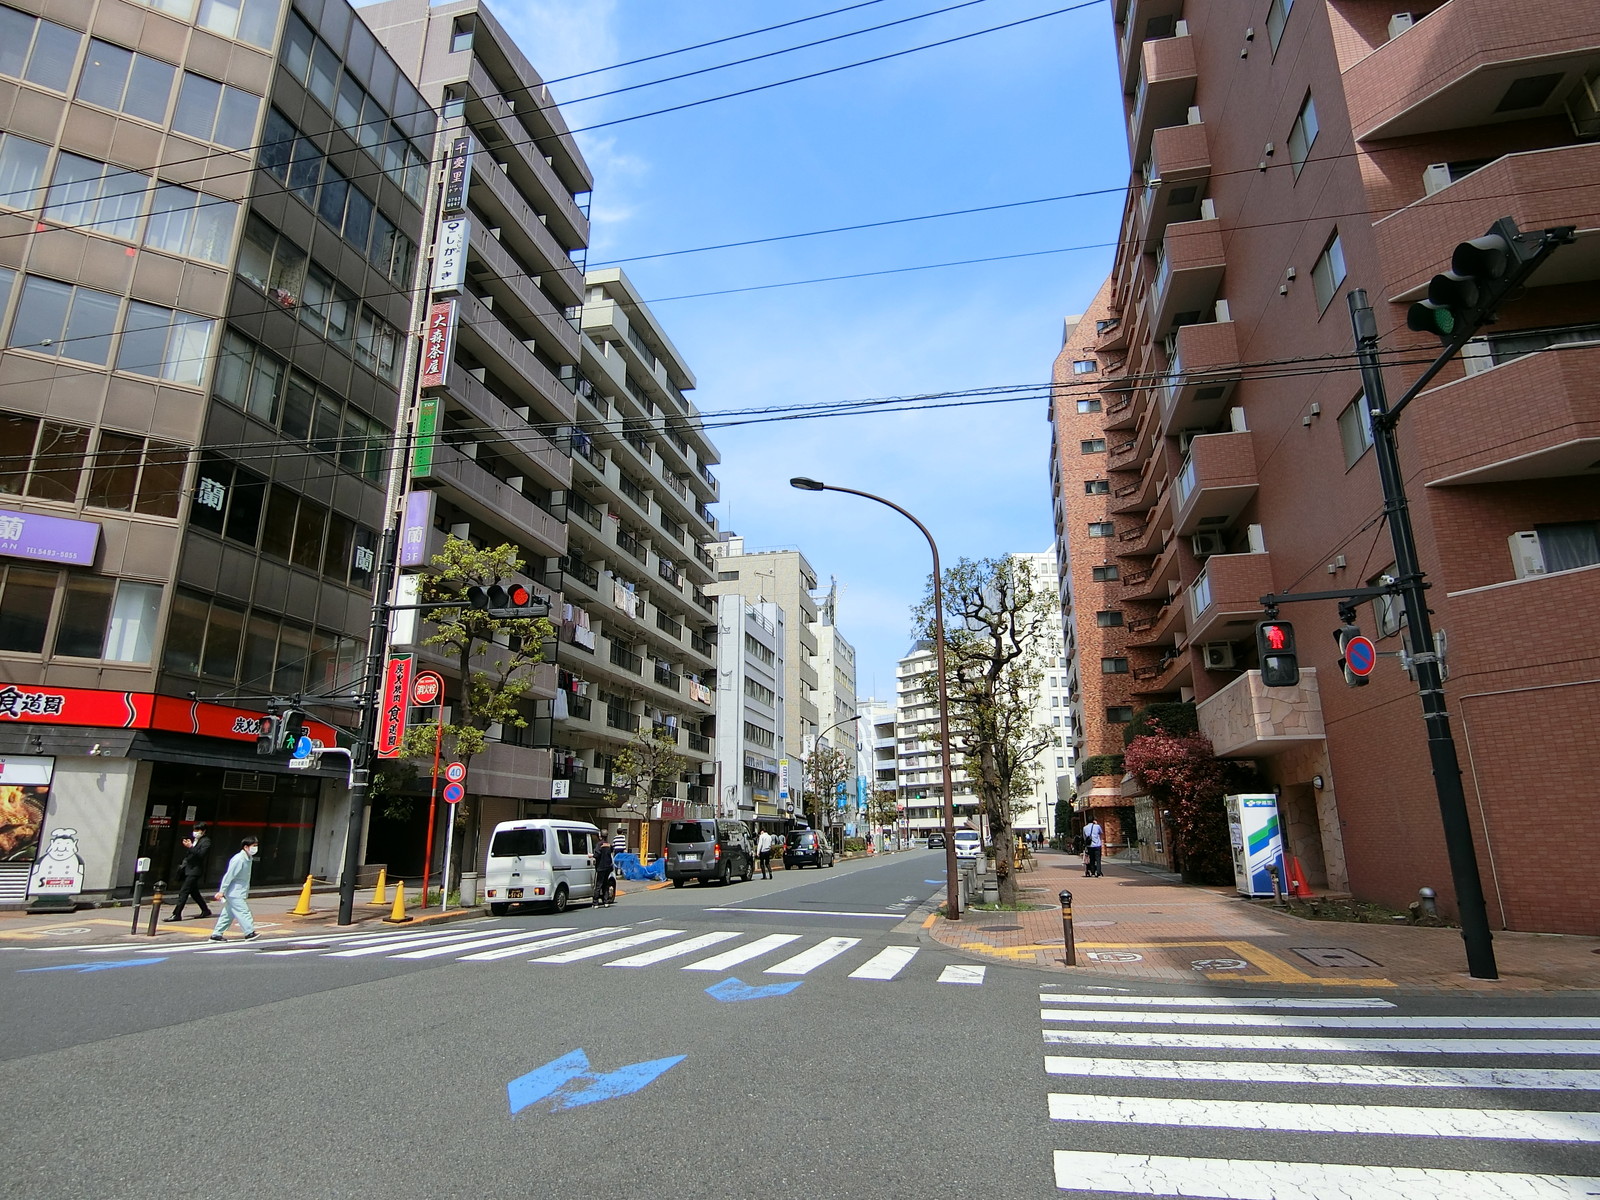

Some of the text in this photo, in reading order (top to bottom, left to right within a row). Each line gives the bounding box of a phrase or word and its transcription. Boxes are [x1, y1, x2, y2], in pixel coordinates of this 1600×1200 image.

[441, 236, 456, 280] しがらき
[425, 313, 447, 375] 大森茶屋
[197, 476, 226, 511] 蘭
[416, 684, 437, 695] 消火栓
[450, 767, 461, 778] 40
